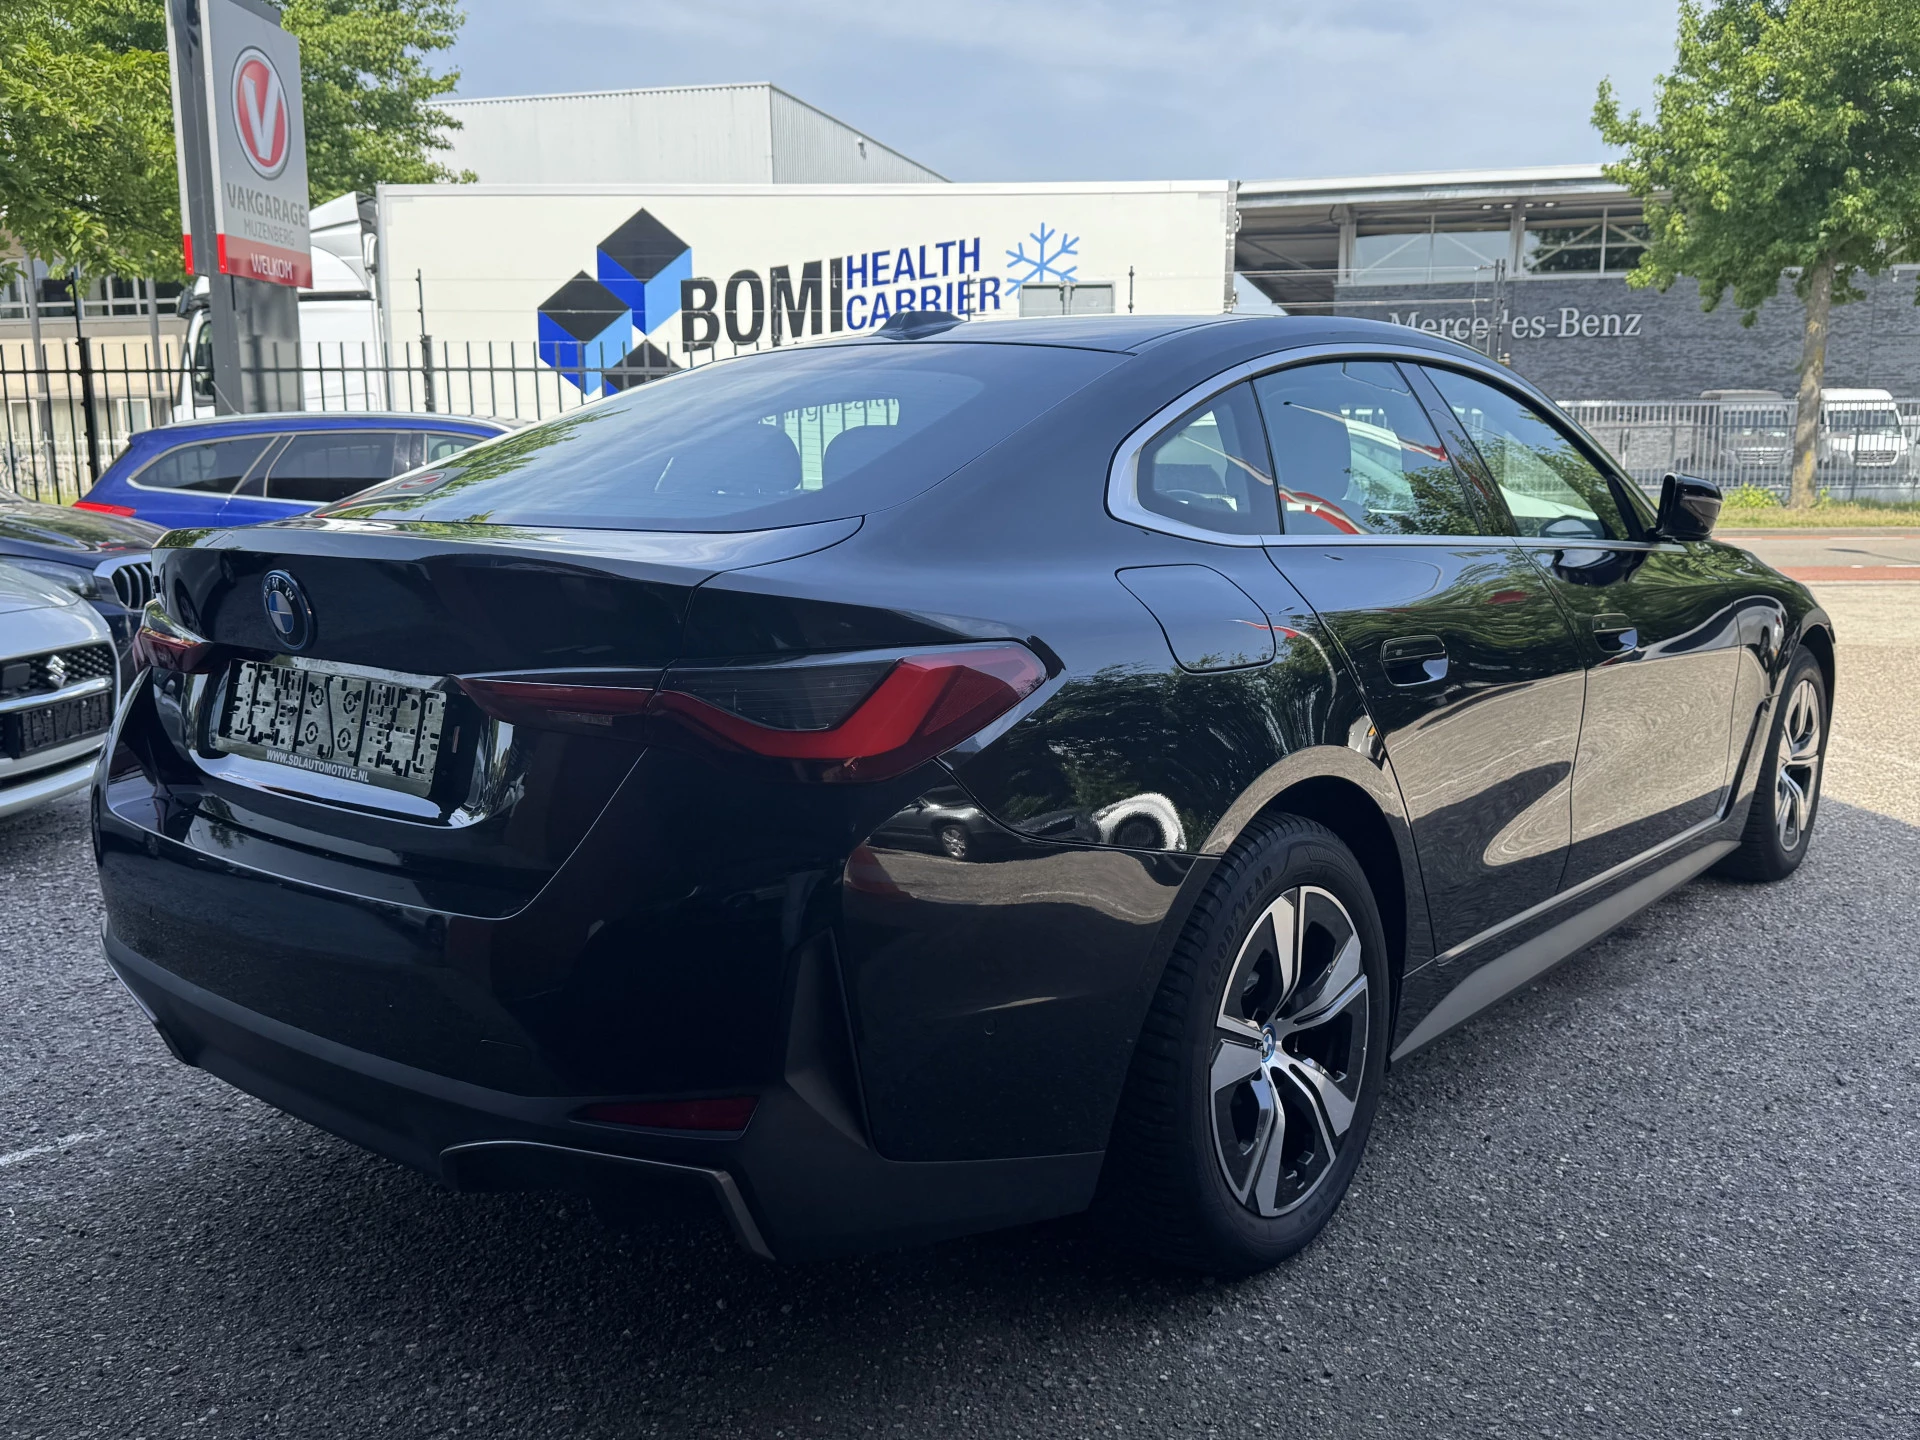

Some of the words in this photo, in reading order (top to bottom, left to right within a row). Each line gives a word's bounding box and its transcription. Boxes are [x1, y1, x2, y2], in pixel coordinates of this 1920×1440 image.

[226, 182, 306, 228] VAKGARAGE
[243, 218, 295, 247] MUZENBERG
[250, 253, 293, 280] WELKOM
[846, 237, 980, 290] HEALTH
[680, 257, 843, 353] BOMI
[846, 276, 1001, 331] CARRIER
[266, 749, 370, 783] WWW.SDLAUTOMOTIVE.NL
